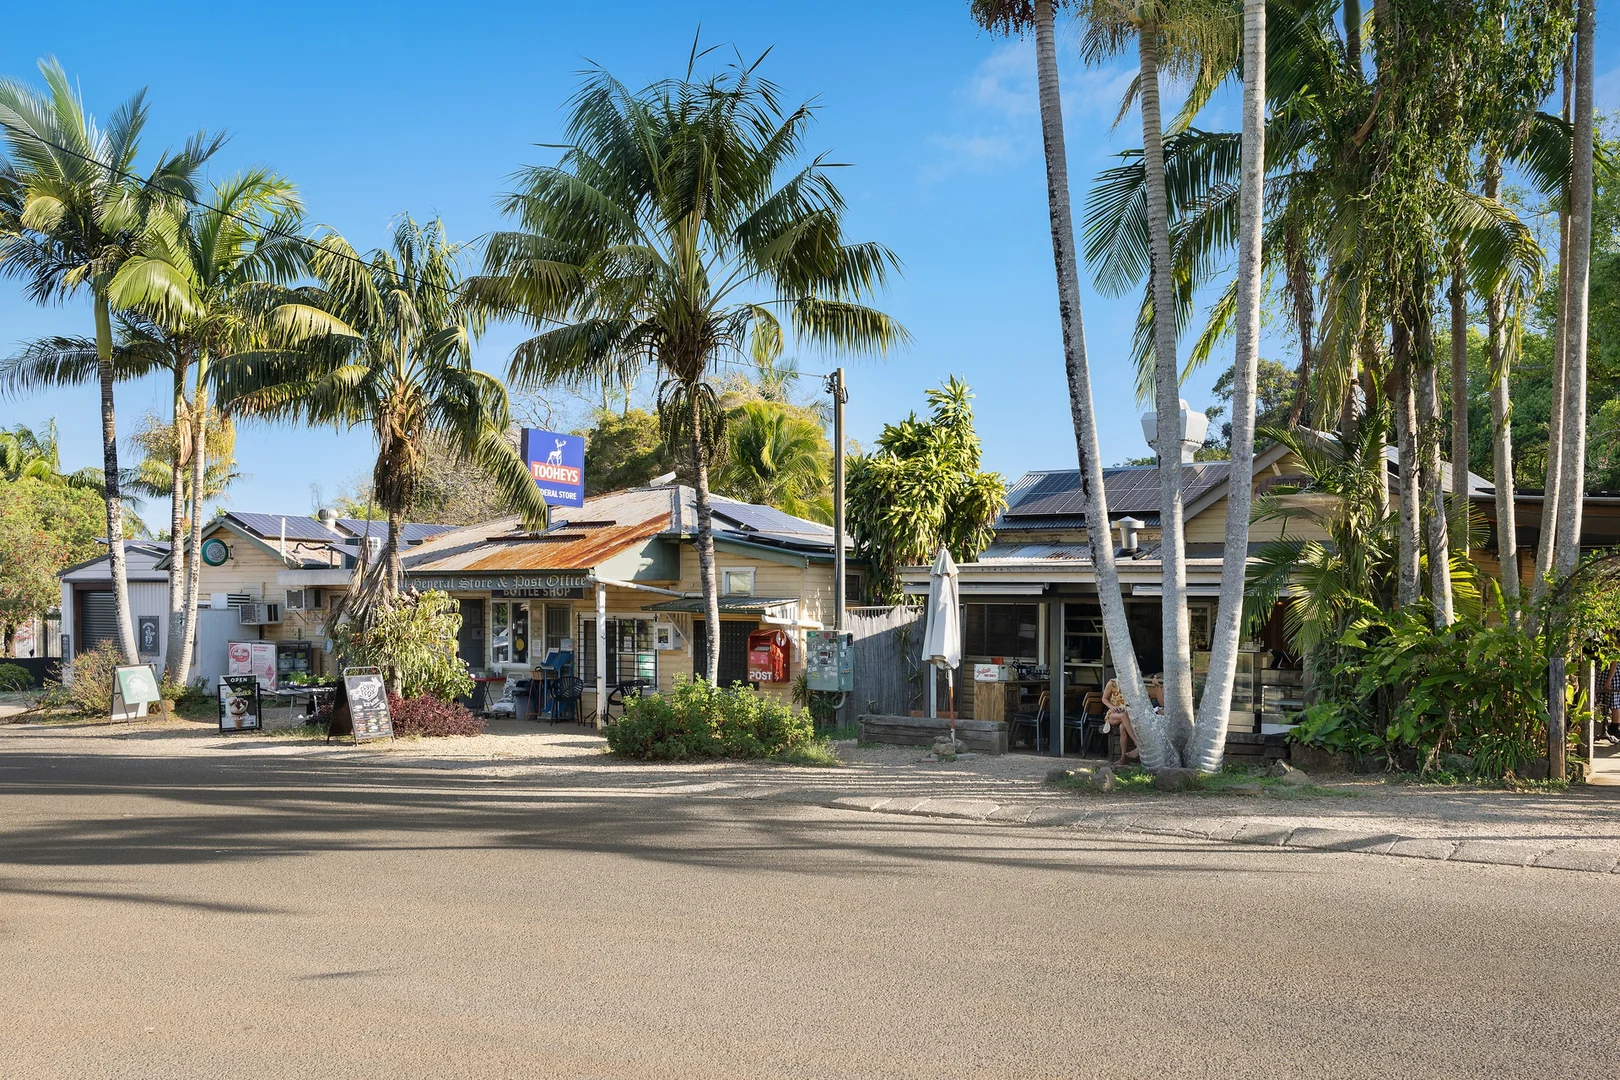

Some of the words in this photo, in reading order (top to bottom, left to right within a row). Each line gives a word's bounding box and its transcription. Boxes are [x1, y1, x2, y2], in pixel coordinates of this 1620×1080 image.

[533, 464, 578, 483] TOOHEYS
[540, 488, 558, 498] DERAL
[559, 491, 577, 500] STORE
[412, 577, 455, 589] General
[458, 577, 493, 589] Store
[496, 575, 508, 588] &
[512, 574, 543, 589] Post
[546, 574, 587, 587] Office
[503, 588, 539, 597] BOTTLE
[542, 588, 571, 597] SHOP
[749, 671, 773, 681] POST
